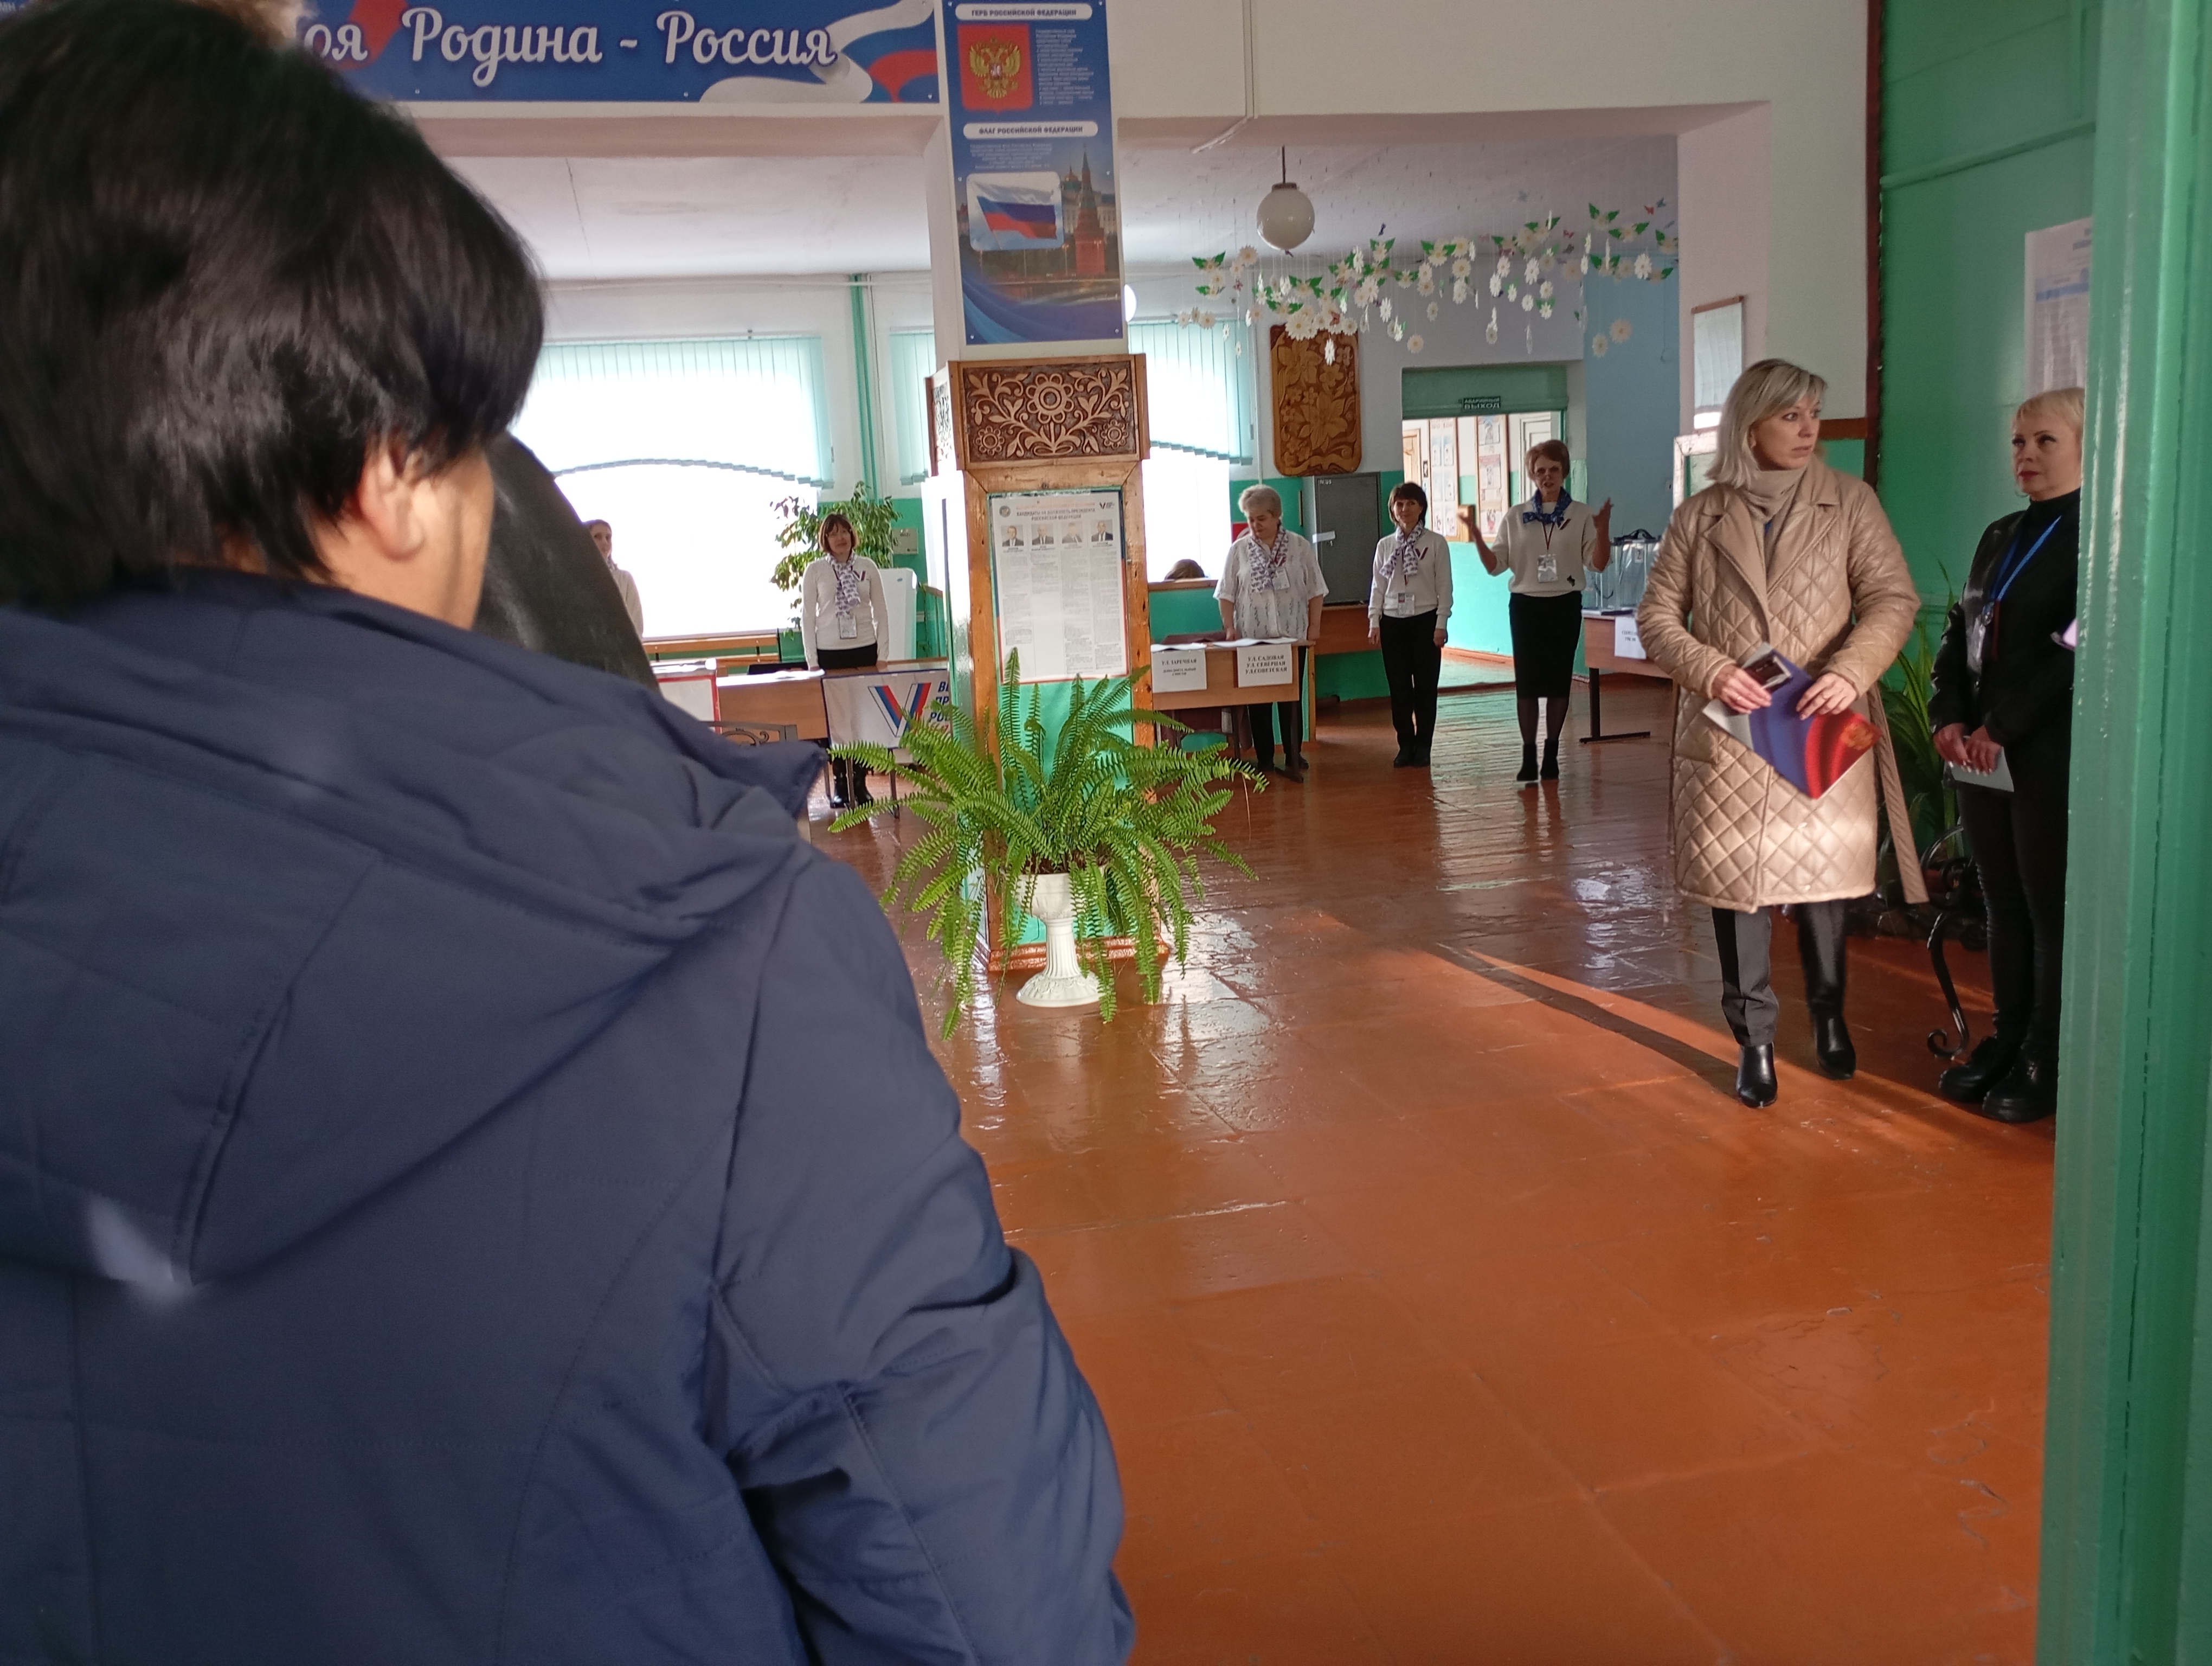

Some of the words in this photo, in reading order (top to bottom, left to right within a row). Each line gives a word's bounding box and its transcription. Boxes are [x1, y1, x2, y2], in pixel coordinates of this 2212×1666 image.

[989, 8, 1035, 16] РОССИЙСКОЙ
[304, 23, 368, 62] оя
[401, 7, 603, 88] Родина
[619, 38, 638, 49] -
[656, 10, 837, 67] Россия
[997, 126, 1042, 134] РОССИЙСКОЙ
